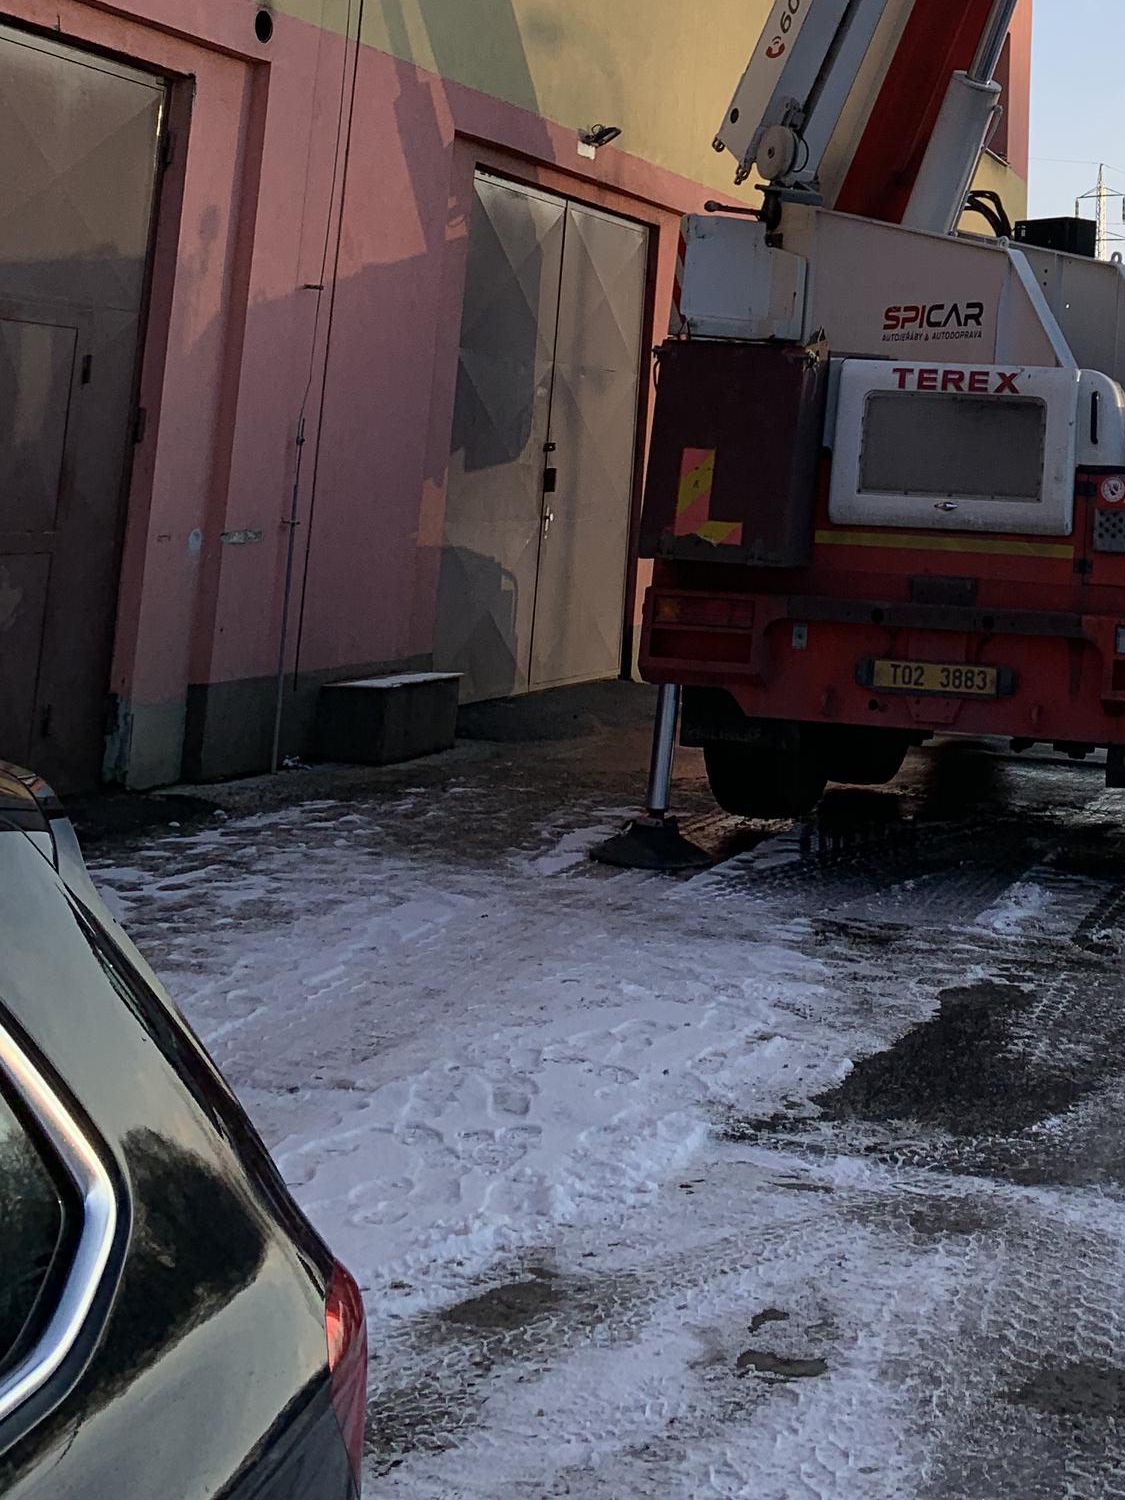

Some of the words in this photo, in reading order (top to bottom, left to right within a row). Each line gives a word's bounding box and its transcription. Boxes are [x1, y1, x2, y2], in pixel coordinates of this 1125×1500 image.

[882, 302, 984, 330] SPICAR
[931, 330, 982, 341] AUTODOPRAVA
[892, 367, 1020, 394] TEREX
[890, 663, 925, 687] T02
[939, 667, 988, 691] 3883
